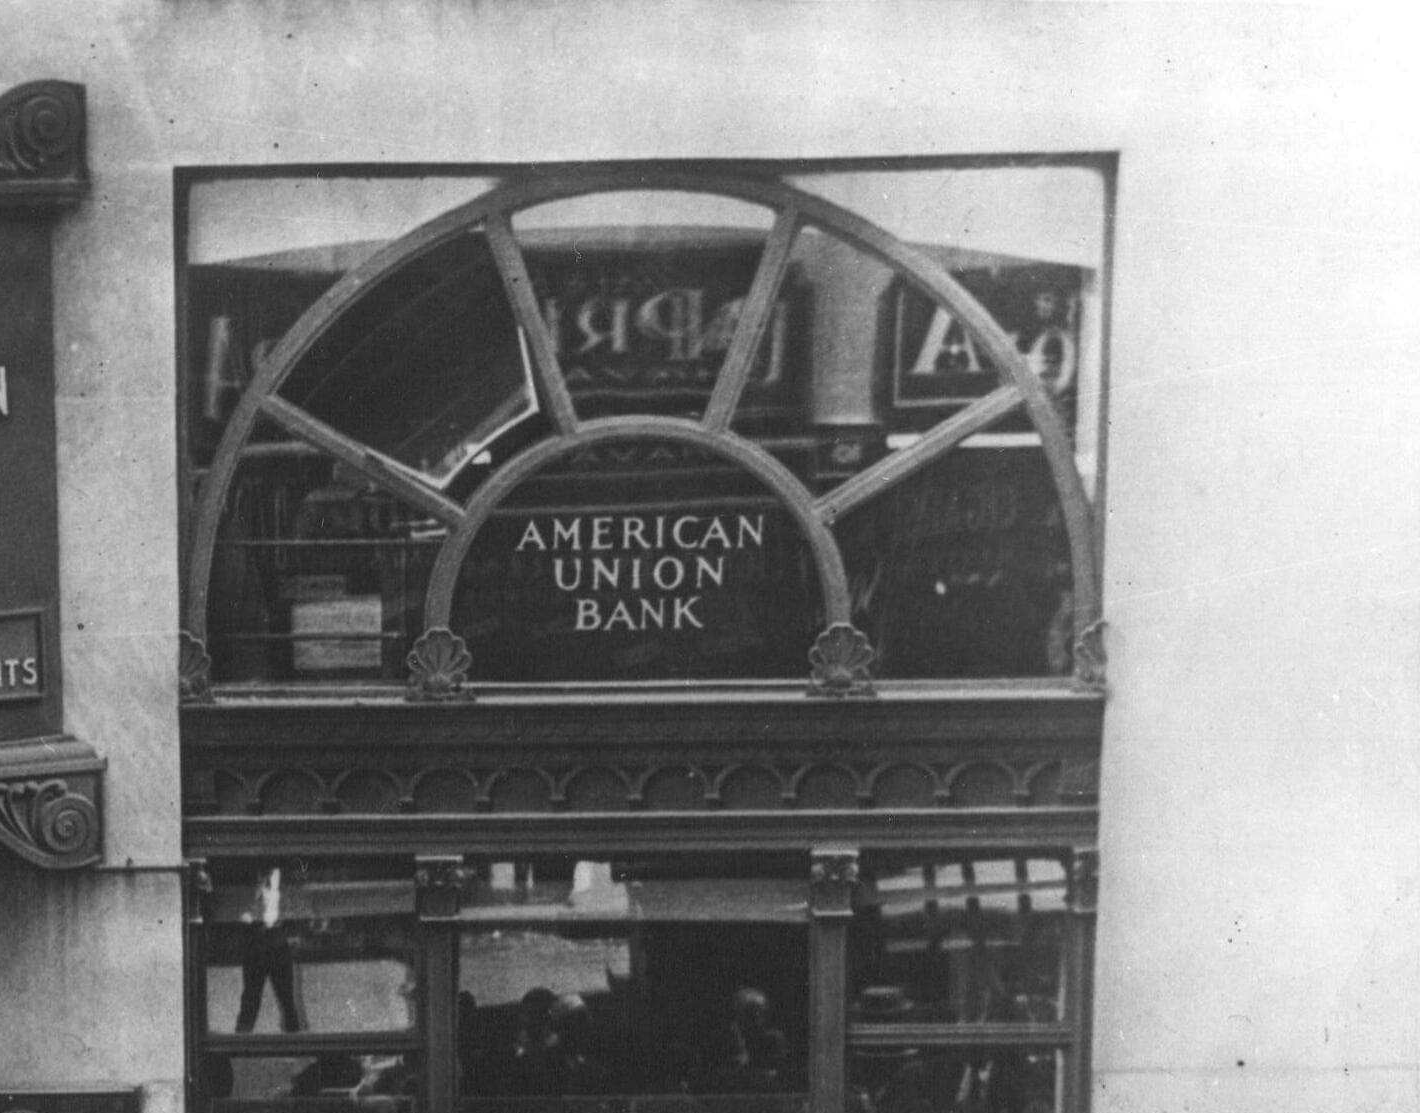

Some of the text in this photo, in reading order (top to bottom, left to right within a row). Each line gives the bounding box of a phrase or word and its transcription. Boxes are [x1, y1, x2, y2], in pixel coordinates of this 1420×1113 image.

[516, 514, 765, 551] AMERICAN
[554, 556, 725, 591] UNION
[575, 596, 705, 631] BANK
